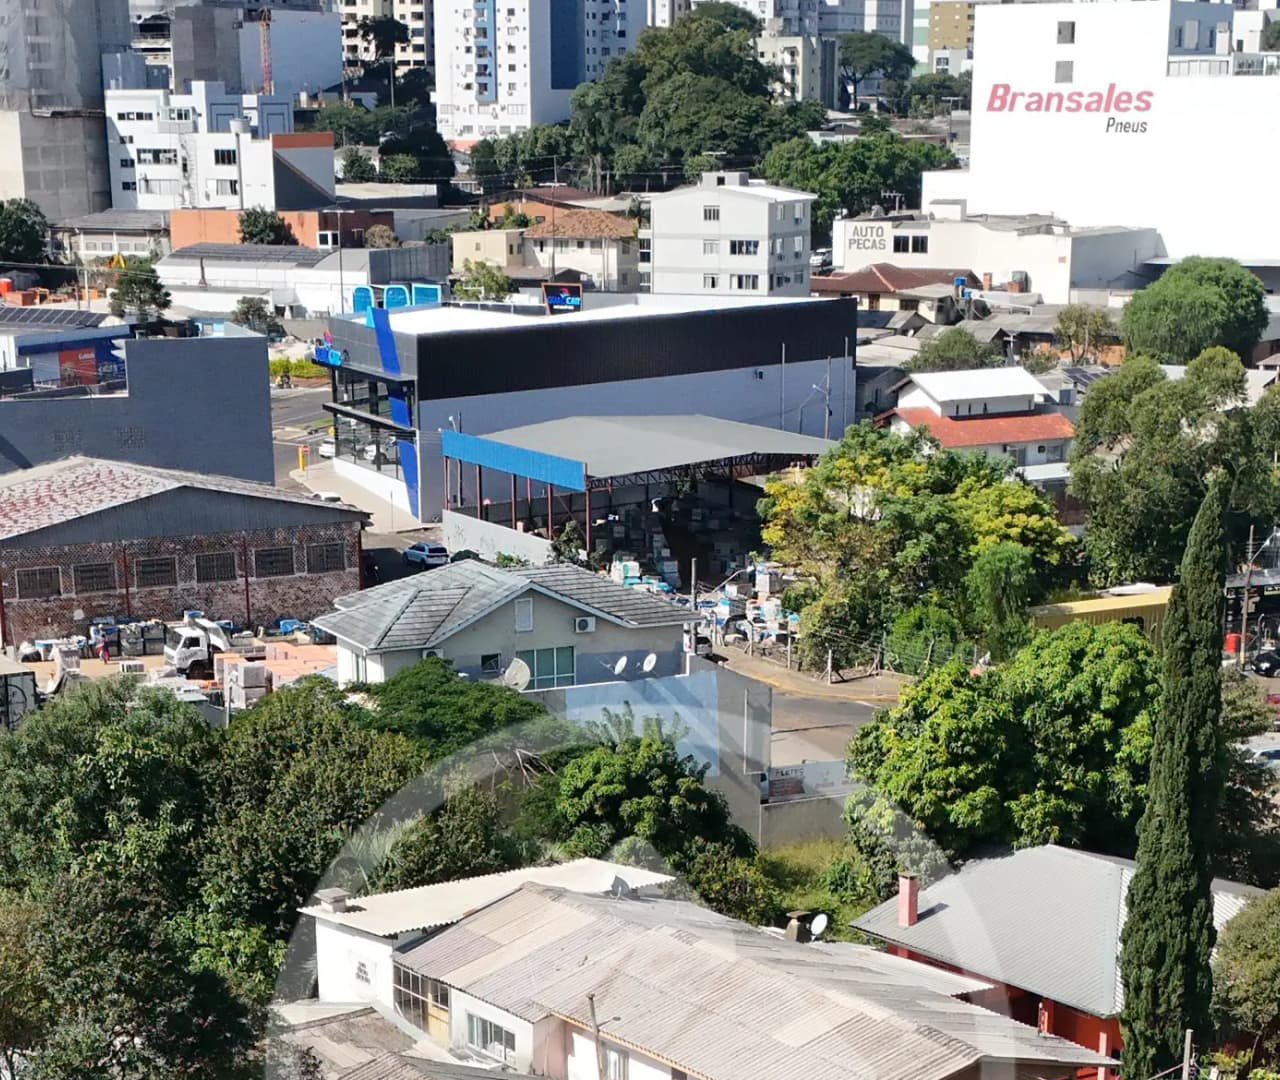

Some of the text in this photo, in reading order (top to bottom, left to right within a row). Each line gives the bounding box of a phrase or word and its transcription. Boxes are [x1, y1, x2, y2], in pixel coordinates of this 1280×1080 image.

[986, 83, 1155, 113] Bransales
[1106, 117, 1148, 133] Pneus
[852, 225, 885, 238] AUTO
